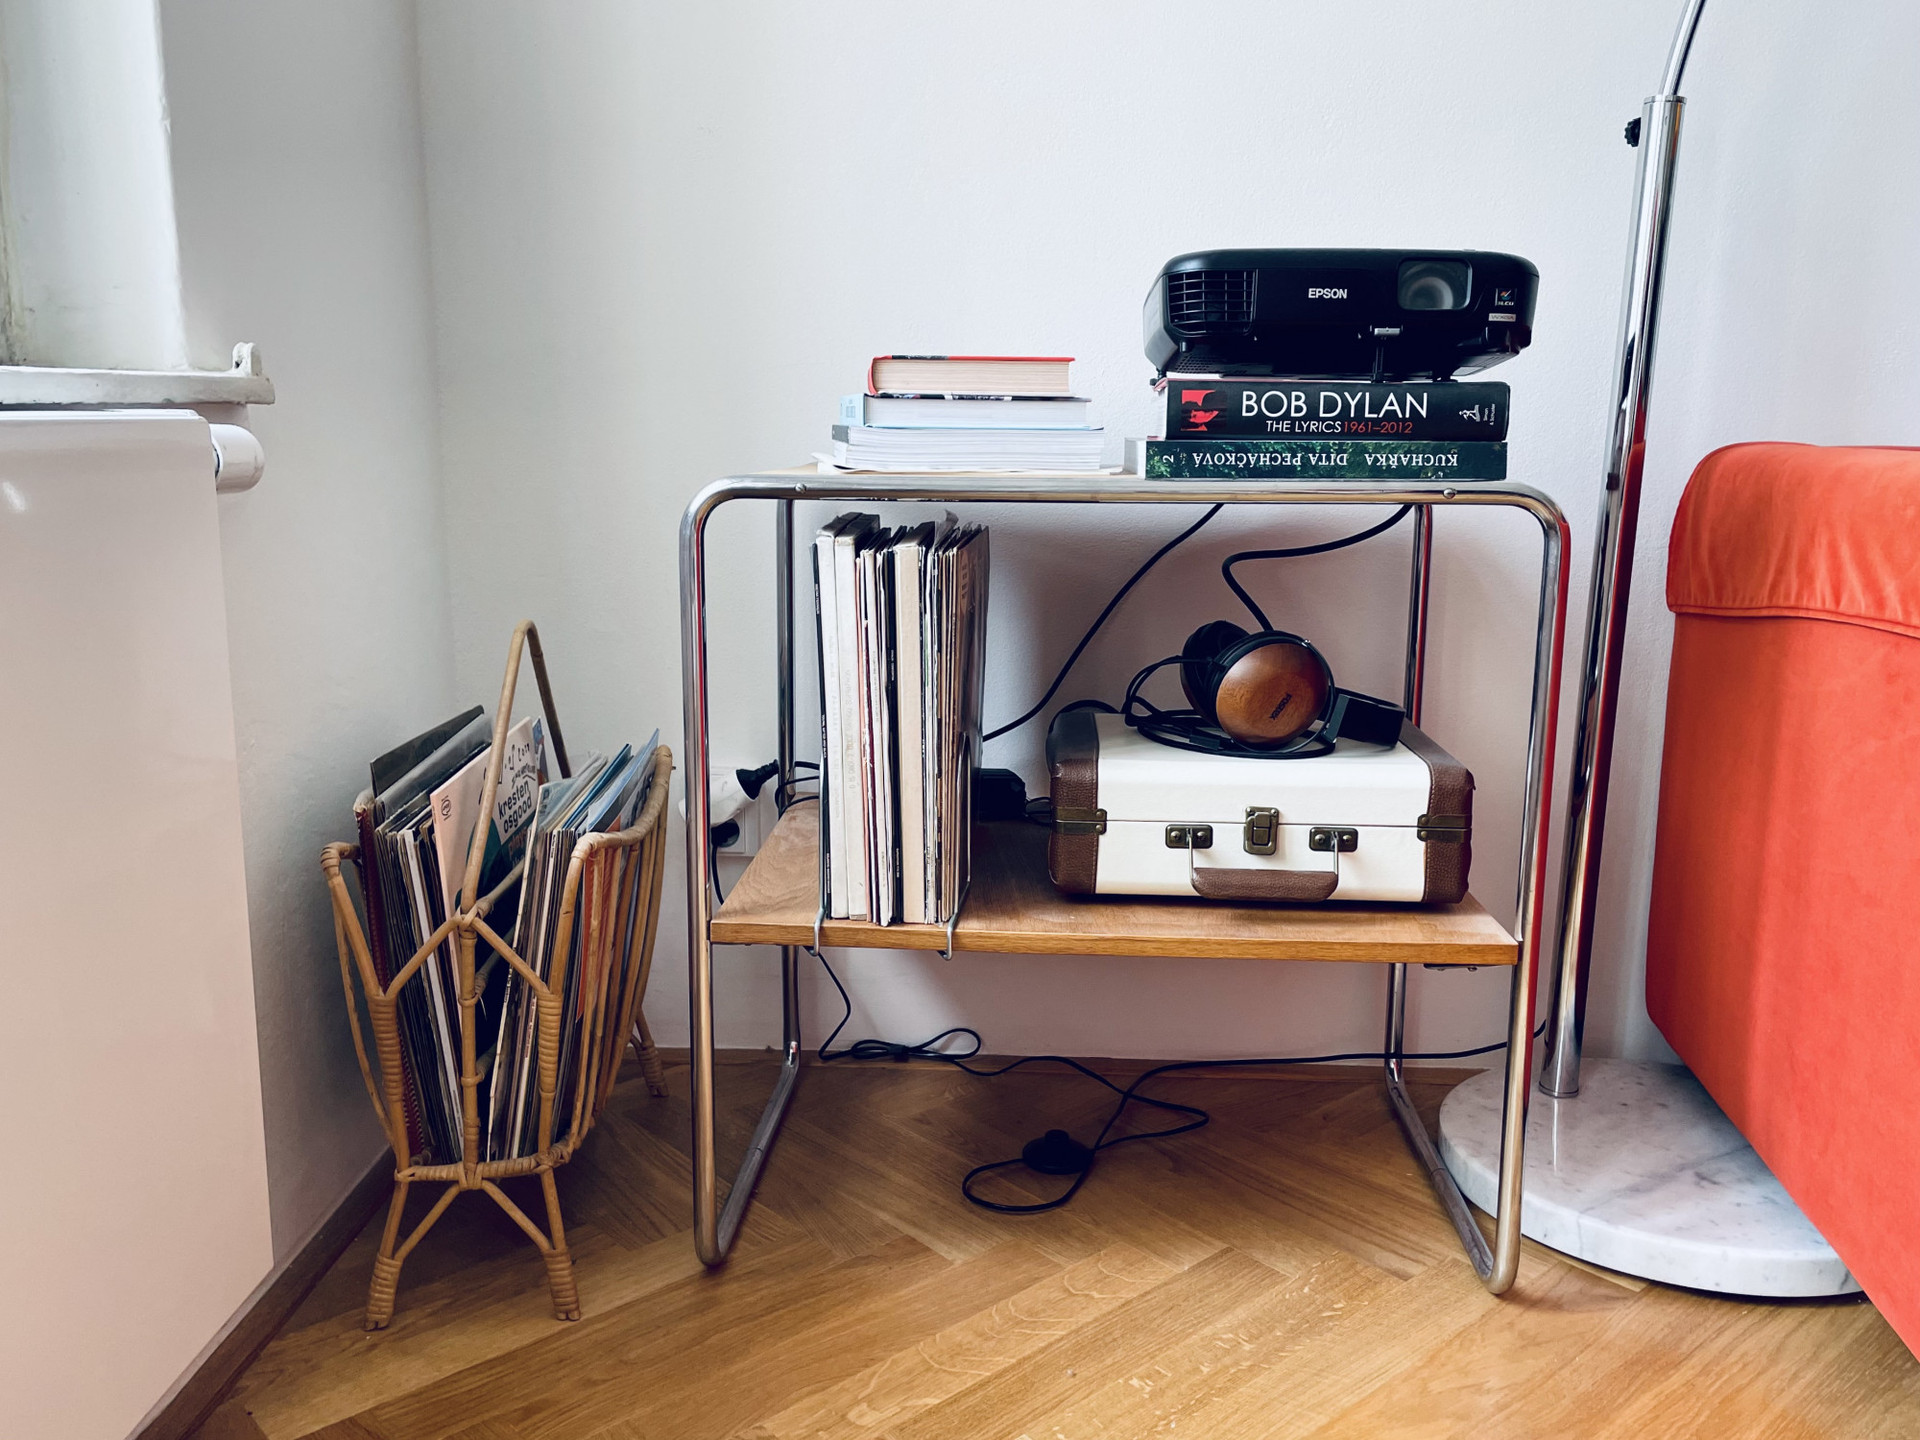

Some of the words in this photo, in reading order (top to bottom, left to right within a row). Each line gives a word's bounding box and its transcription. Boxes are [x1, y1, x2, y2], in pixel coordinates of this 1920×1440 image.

[1308, 287, 1348, 299] EPSON
[1241, 390, 1308, 418] BOB
[1318, 391, 1428, 419] DYLAN
[1265, 420, 1292, 433] THE
[1294, 420, 1342, 433] LYRICS
[1191, 452, 1302, 469] PECHÁČKOVÁ
[1307, 453, 1349, 467] DITA
[1363, 453, 1458, 469] KUCHAŘKA
[498, 780, 530, 820] kresten
[503, 796, 532, 834] osgood
